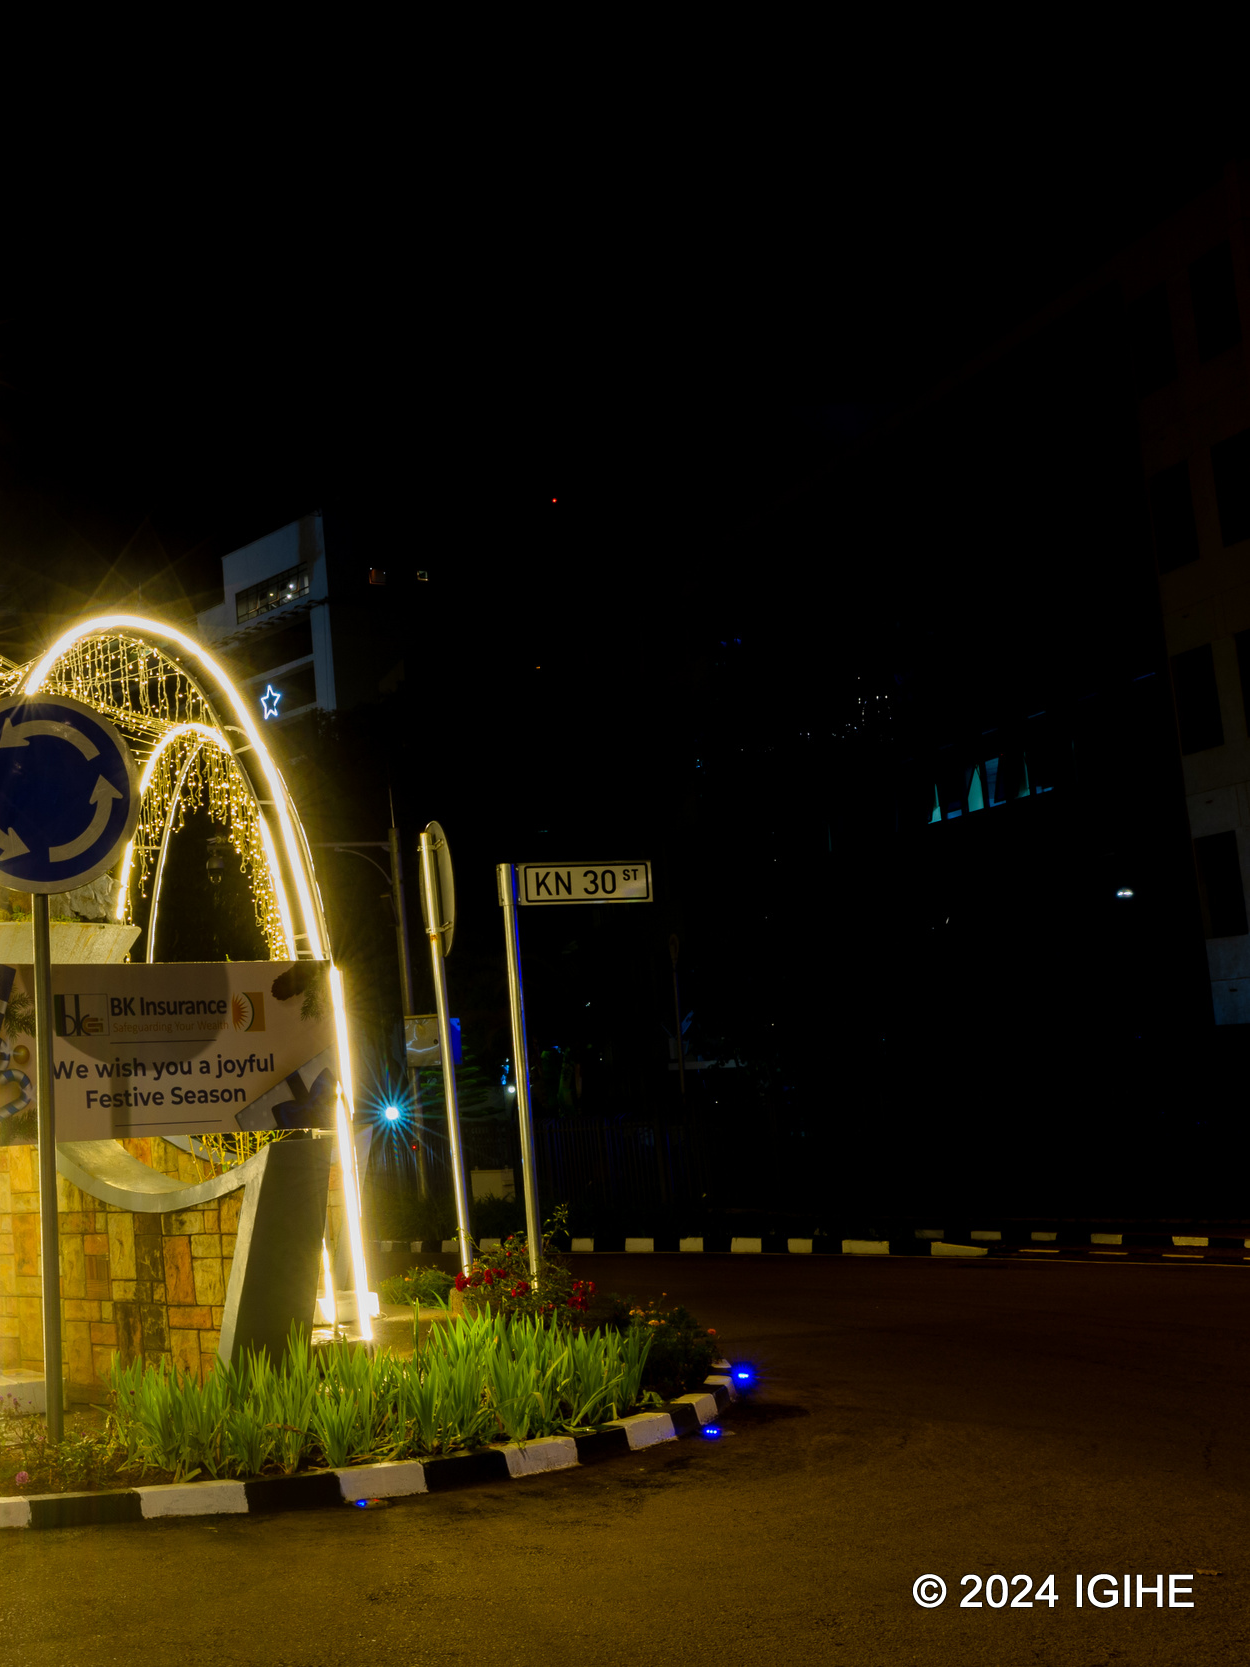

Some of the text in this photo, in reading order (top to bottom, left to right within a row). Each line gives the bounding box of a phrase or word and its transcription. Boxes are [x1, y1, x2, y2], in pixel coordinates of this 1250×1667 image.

[535, 869, 639, 896] KN 30 ST
[110, 997, 228, 1016] BK Insurance
[113, 1018, 229, 1034] Safeguarding Your Wealth
[53, 1053, 275, 1081] We wish you a joyful
[85, 1086, 247, 1109] Festive Season
